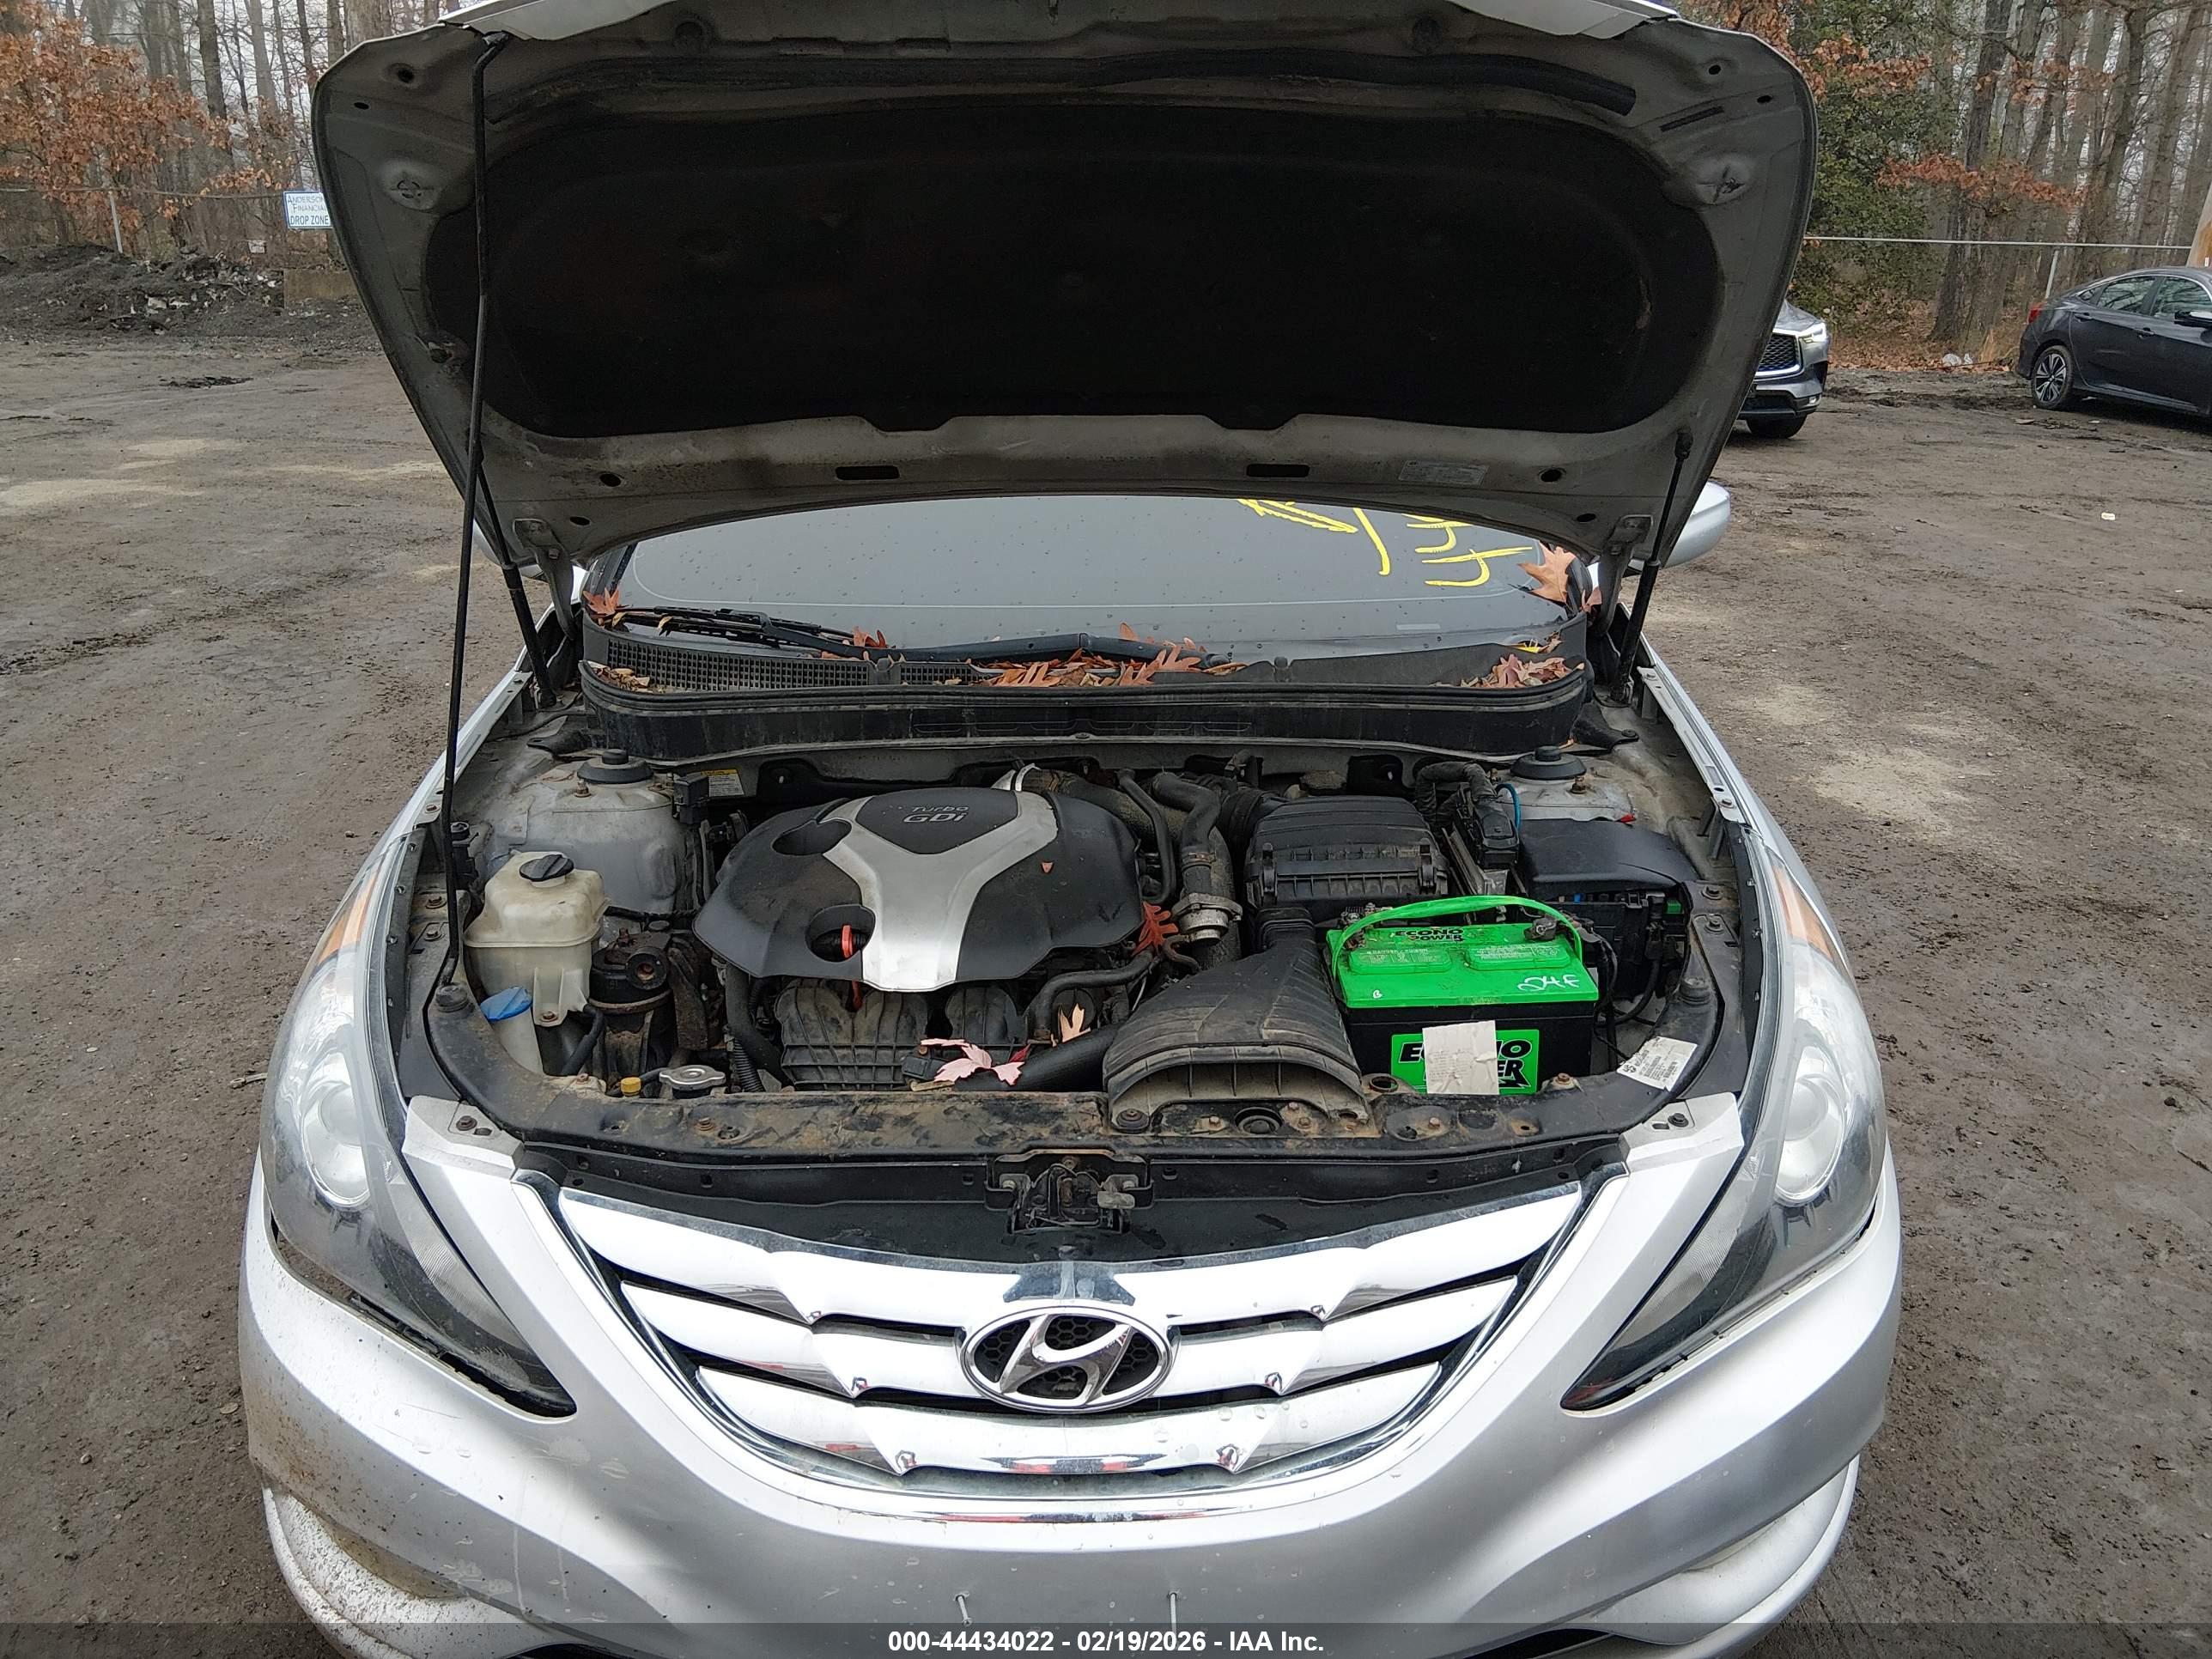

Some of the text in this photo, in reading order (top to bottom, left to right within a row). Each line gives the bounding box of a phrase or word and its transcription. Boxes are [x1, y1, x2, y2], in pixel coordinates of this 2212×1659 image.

[290, 215, 329, 225] DROP ZONE
[903, 812, 967, 823] GDi
